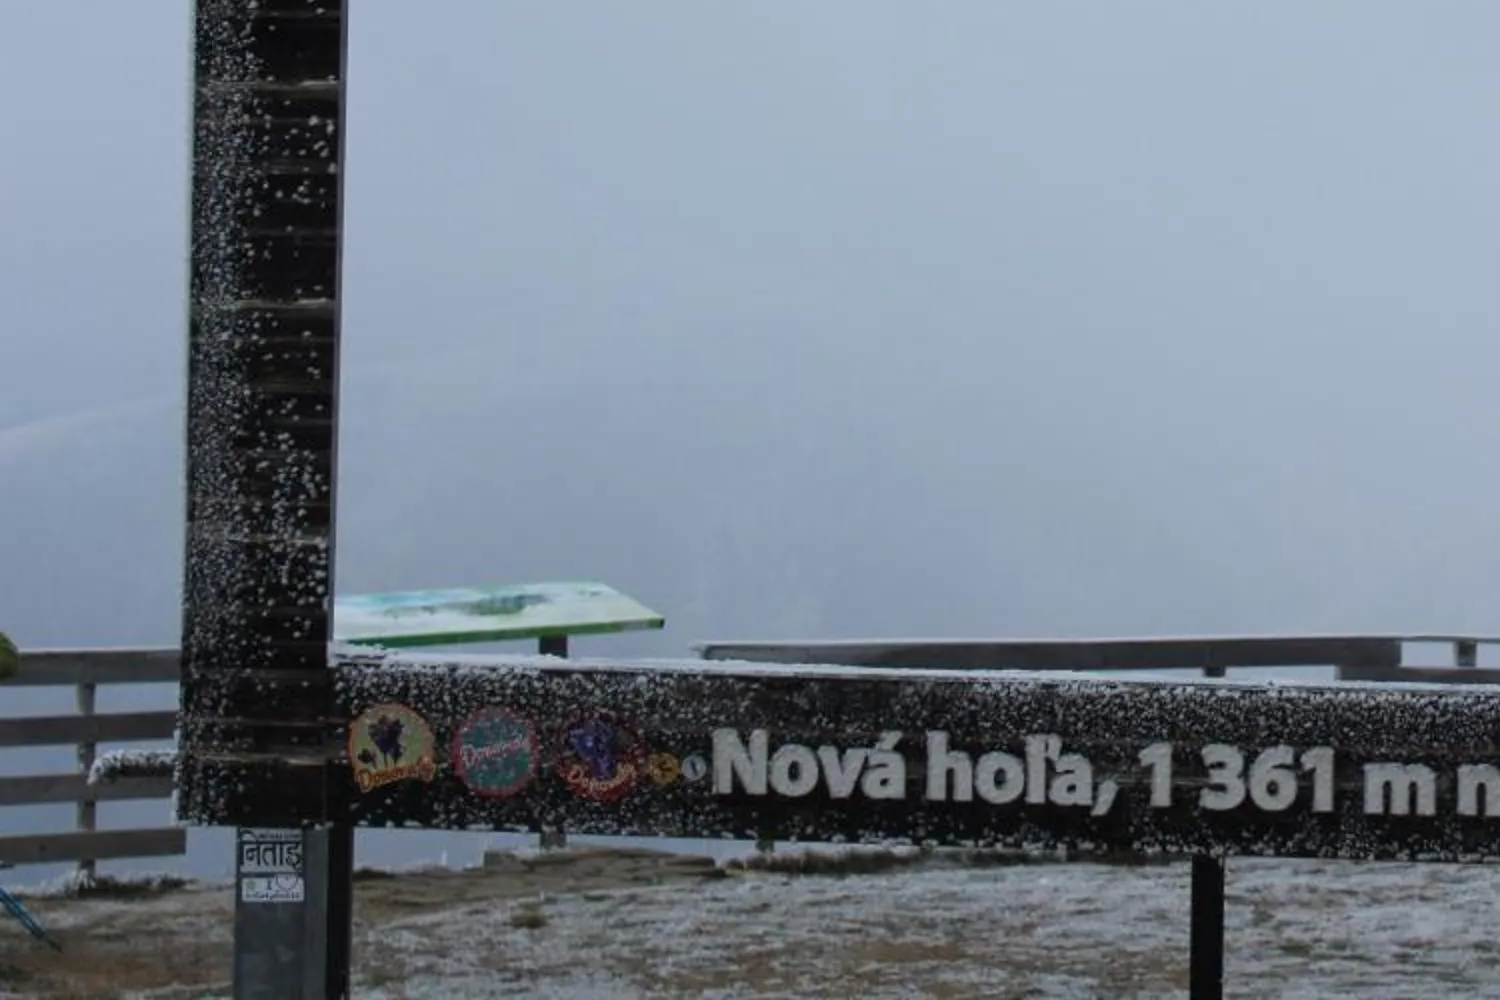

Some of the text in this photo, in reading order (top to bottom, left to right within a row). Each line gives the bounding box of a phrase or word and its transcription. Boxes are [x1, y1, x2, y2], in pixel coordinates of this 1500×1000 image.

[711, 728, 906, 798] Nová
[926, 729, 1120, 816] hoľa,
[1138, 742, 1175, 808] 1
[1200, 743, 1335, 812] 361
[1363, 762, 1437, 816] m
